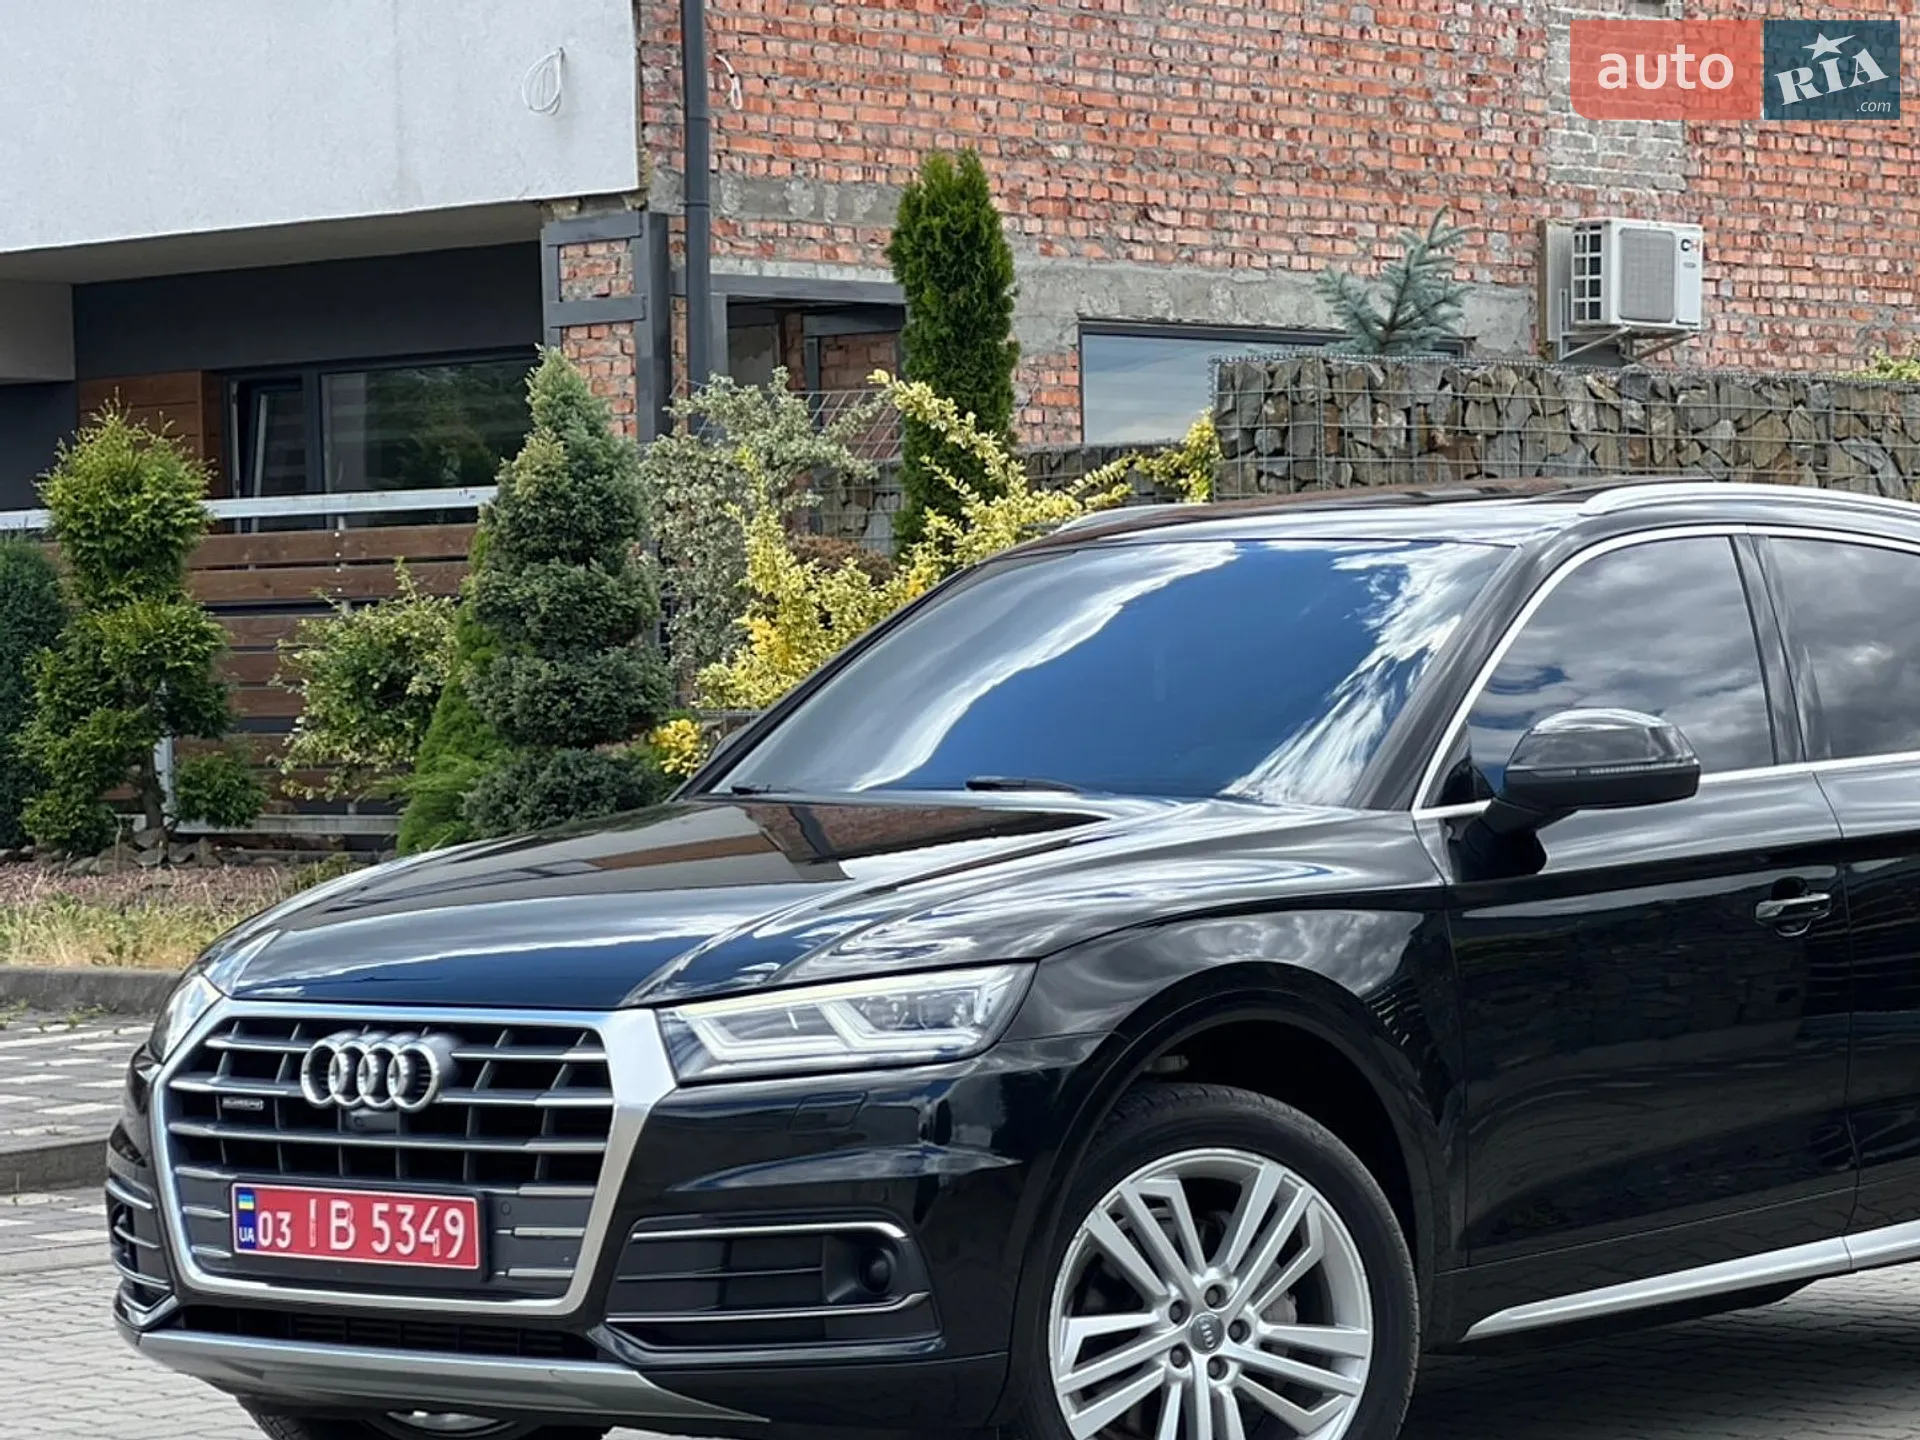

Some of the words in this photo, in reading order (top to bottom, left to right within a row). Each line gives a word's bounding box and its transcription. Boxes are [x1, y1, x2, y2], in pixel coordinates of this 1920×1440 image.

[239, 1226, 255, 1243] UA
[258, 1211, 292, 1248] 03
[371, 1202, 465, 1259] 5349
